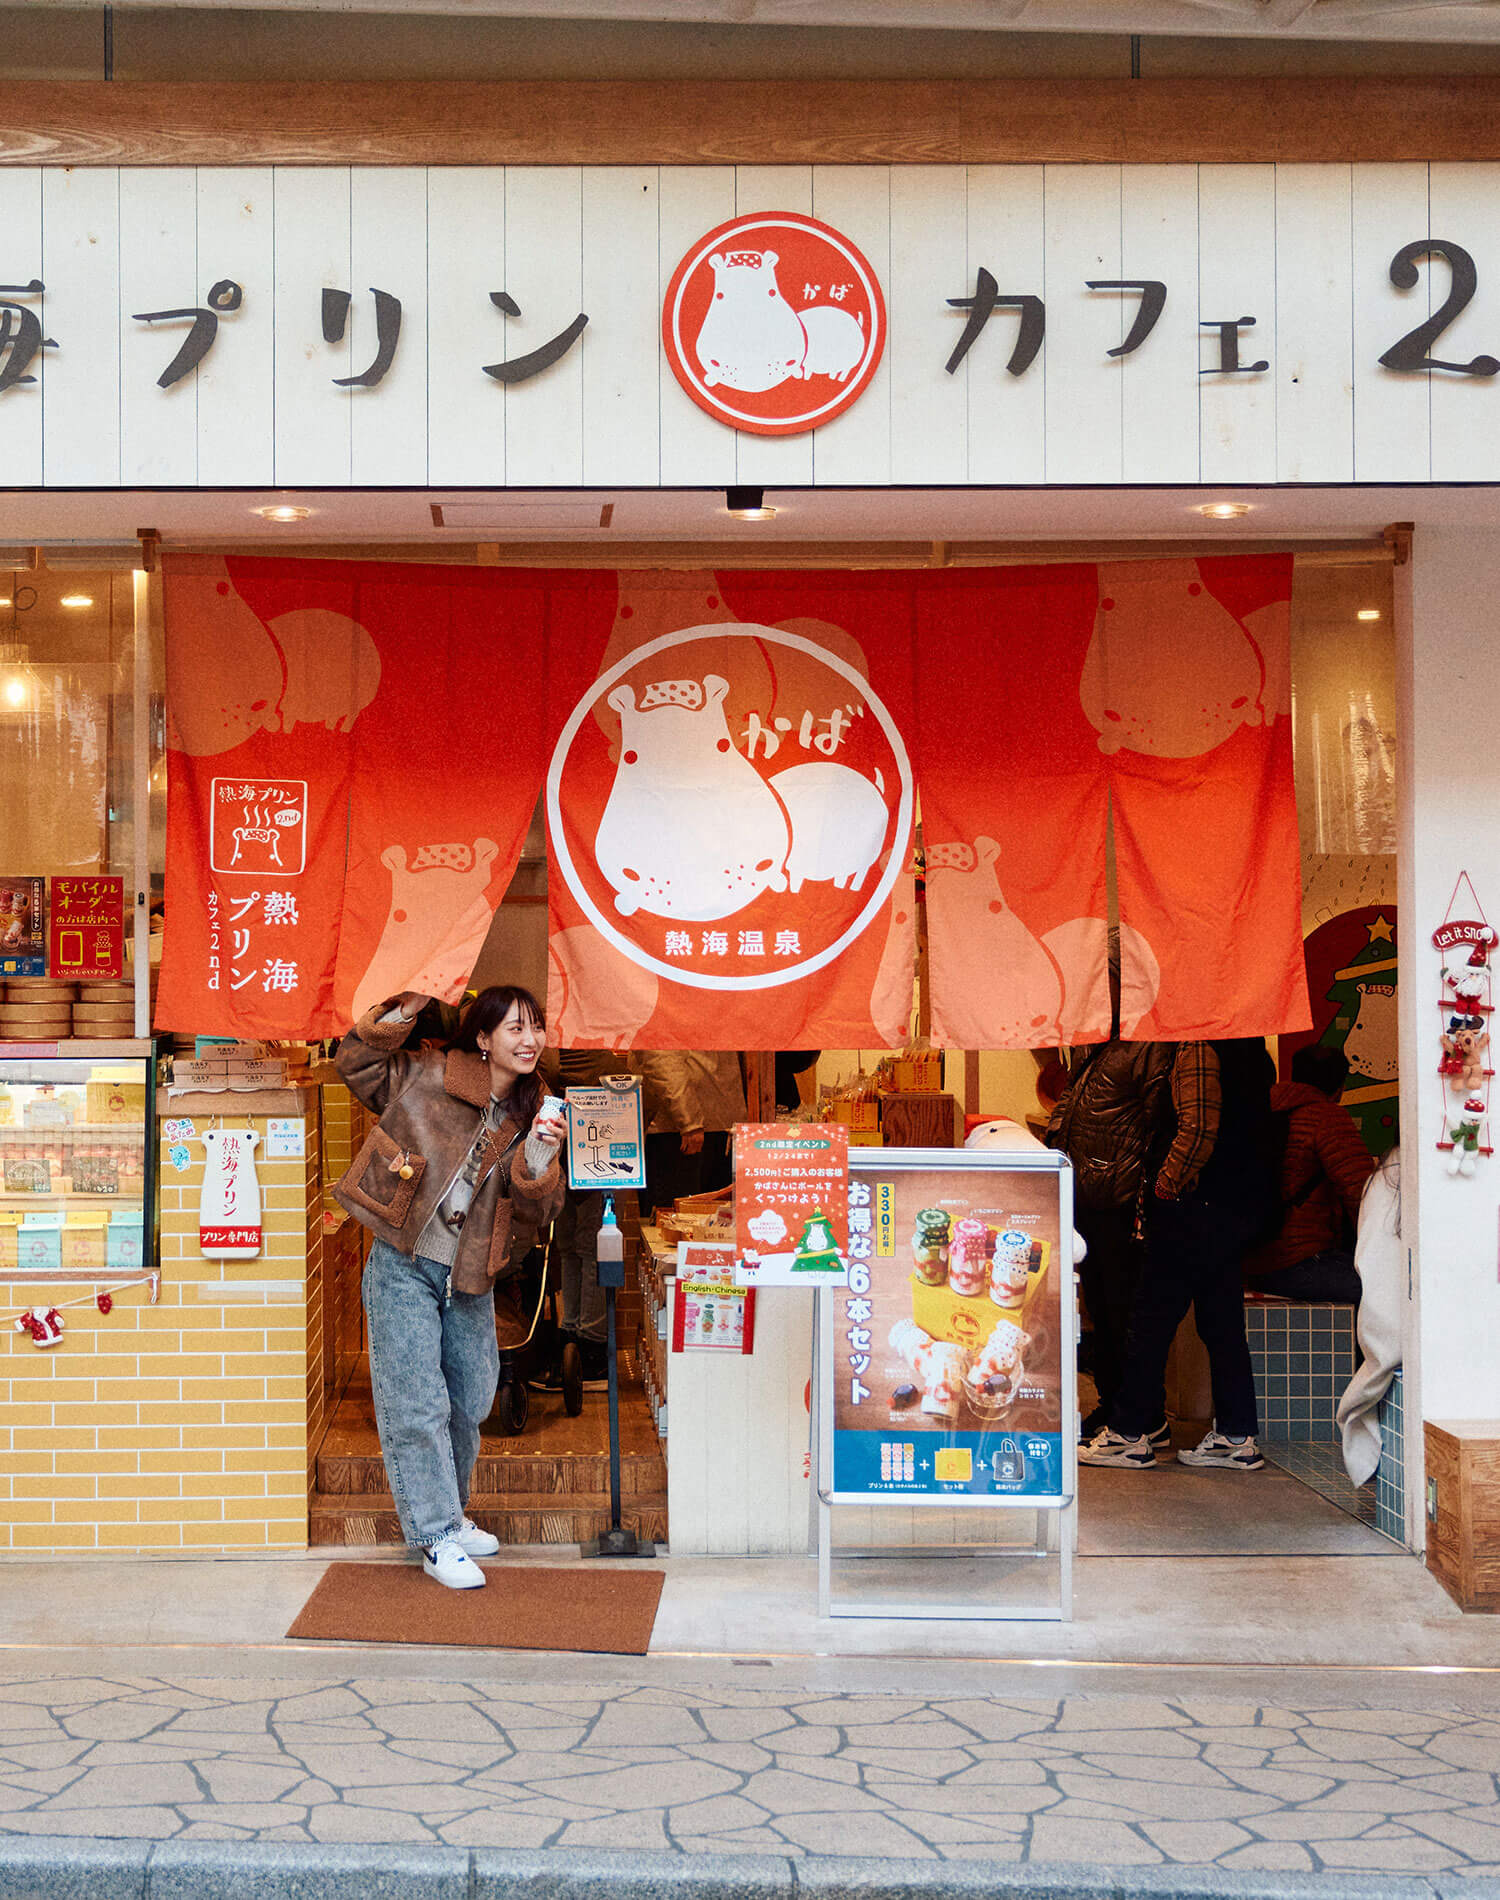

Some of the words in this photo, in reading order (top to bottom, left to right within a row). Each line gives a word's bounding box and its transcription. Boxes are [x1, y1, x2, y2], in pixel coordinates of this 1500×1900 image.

[802, 282, 855, 302] かば
[946, 266, 1269, 377] カフェ
[1378, 238, 1498, 376] 2
[740, 703, 865, 760] かば
[218, 784, 300, 806] 熱海プリン
[55, 881, 120, 895] モバイル
[58, 895, 117, 910] オーダー
[207, 890, 221, 991] カフェ2nd
[229, 890, 261, 991] プリン
[261, 891, 299, 993] 熱海
[664, 929, 802, 957] 熱海温泉
[221, 1136, 240, 1217] 熱海プリン
[755, 1193, 830, 1204] くっつけよう!
[201, 1230, 259, 1244] プリン専門店
[848, 1181, 872, 1405] お得な6本セット
